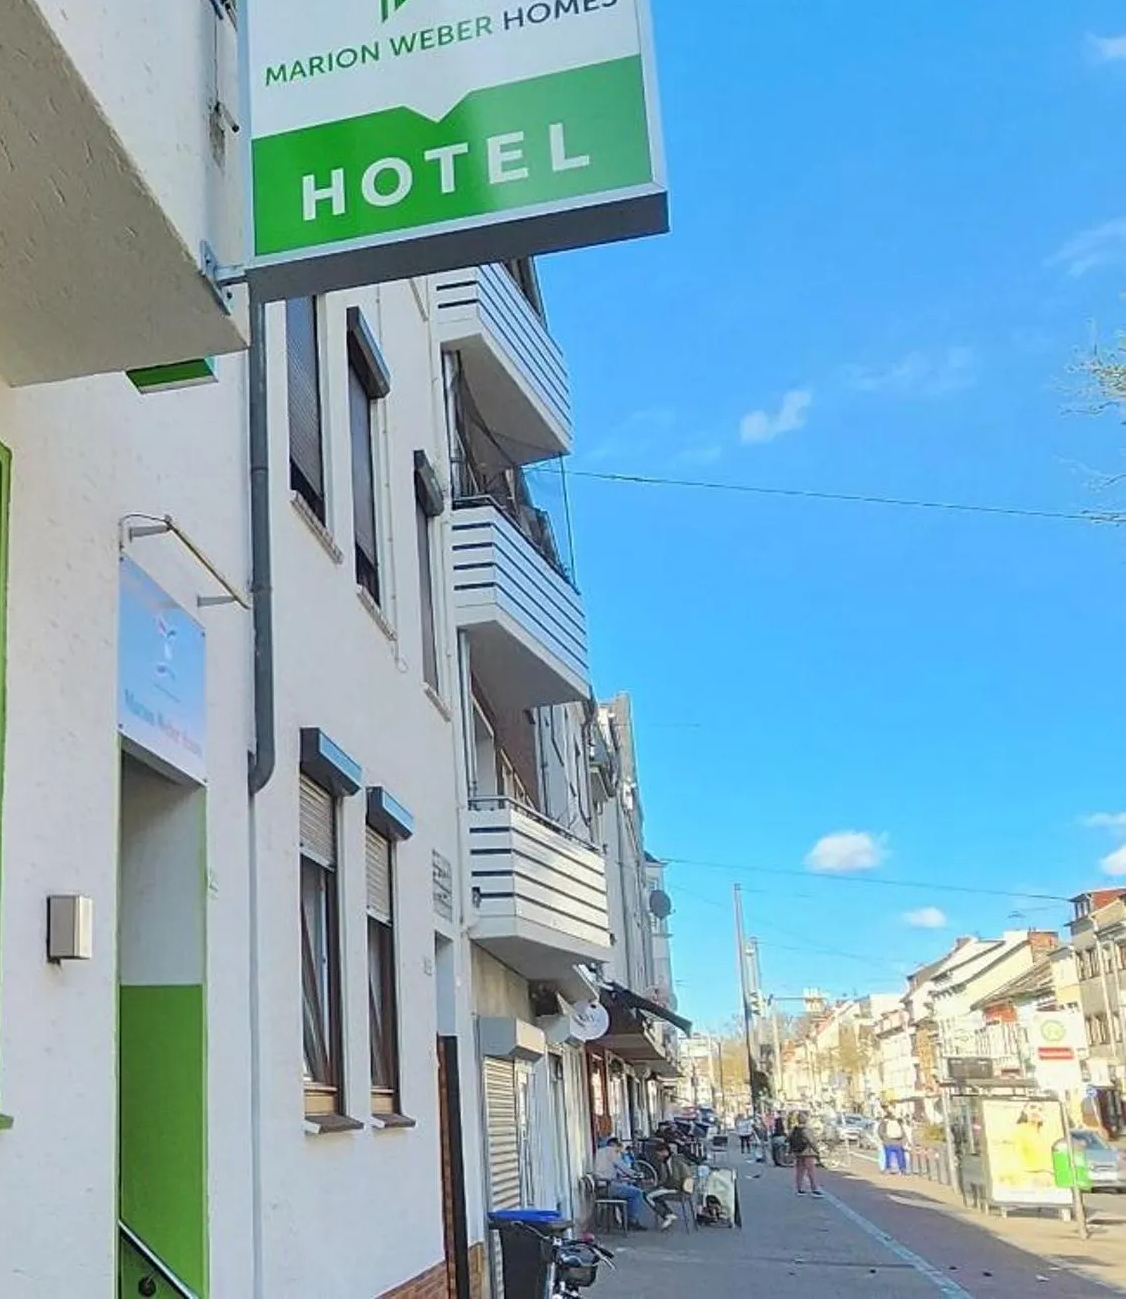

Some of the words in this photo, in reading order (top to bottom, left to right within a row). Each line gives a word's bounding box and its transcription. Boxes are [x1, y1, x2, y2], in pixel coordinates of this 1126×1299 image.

[265, 41, 381, 86] MARION
[390, 15, 493, 57] WEBER
[301, 122, 590, 222] HOTEL
